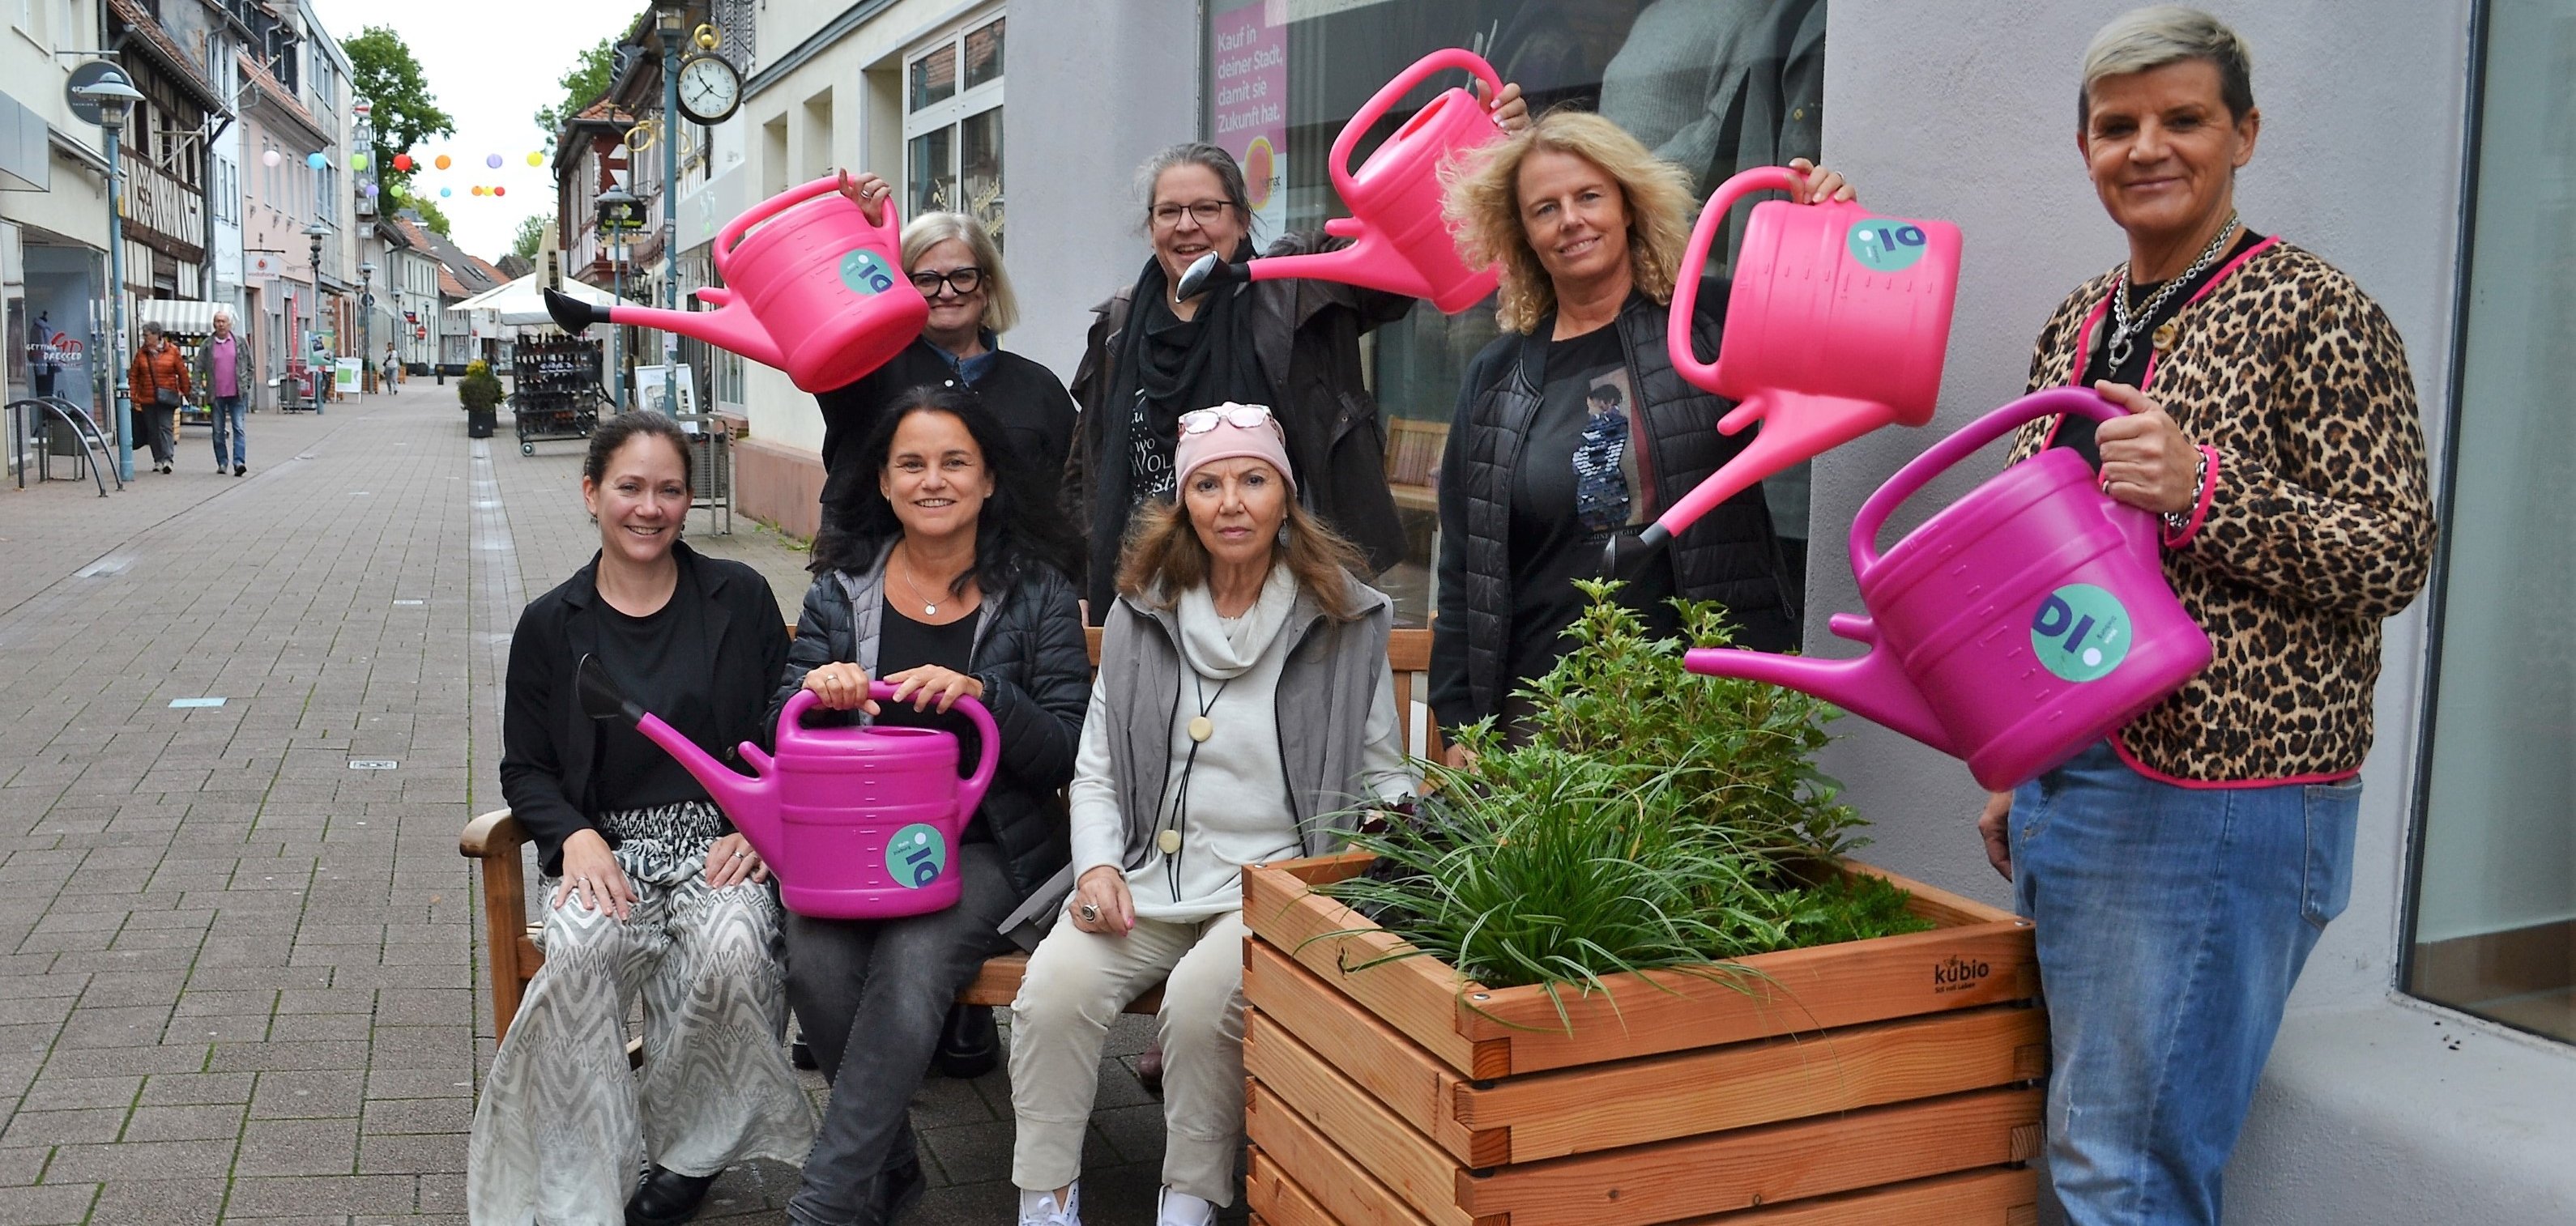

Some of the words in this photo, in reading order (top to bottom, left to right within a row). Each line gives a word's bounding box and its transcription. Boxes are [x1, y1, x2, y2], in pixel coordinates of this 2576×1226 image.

[1218, 27, 1244, 52] Kauf
[1247, 23, 1256, 45] in
[1218, 55, 1252, 79] deiner
[1254, 44, 1282, 70] Stadt,
[1218, 80, 1250, 106] damit
[1252, 75, 1267, 98] sie
[1218, 104, 1260, 133] Zukunft
[1261, 102, 1280, 123] hat.
[25, 343, 57, 351] GETTING
[43, 351, 82, 361] DRESSED
